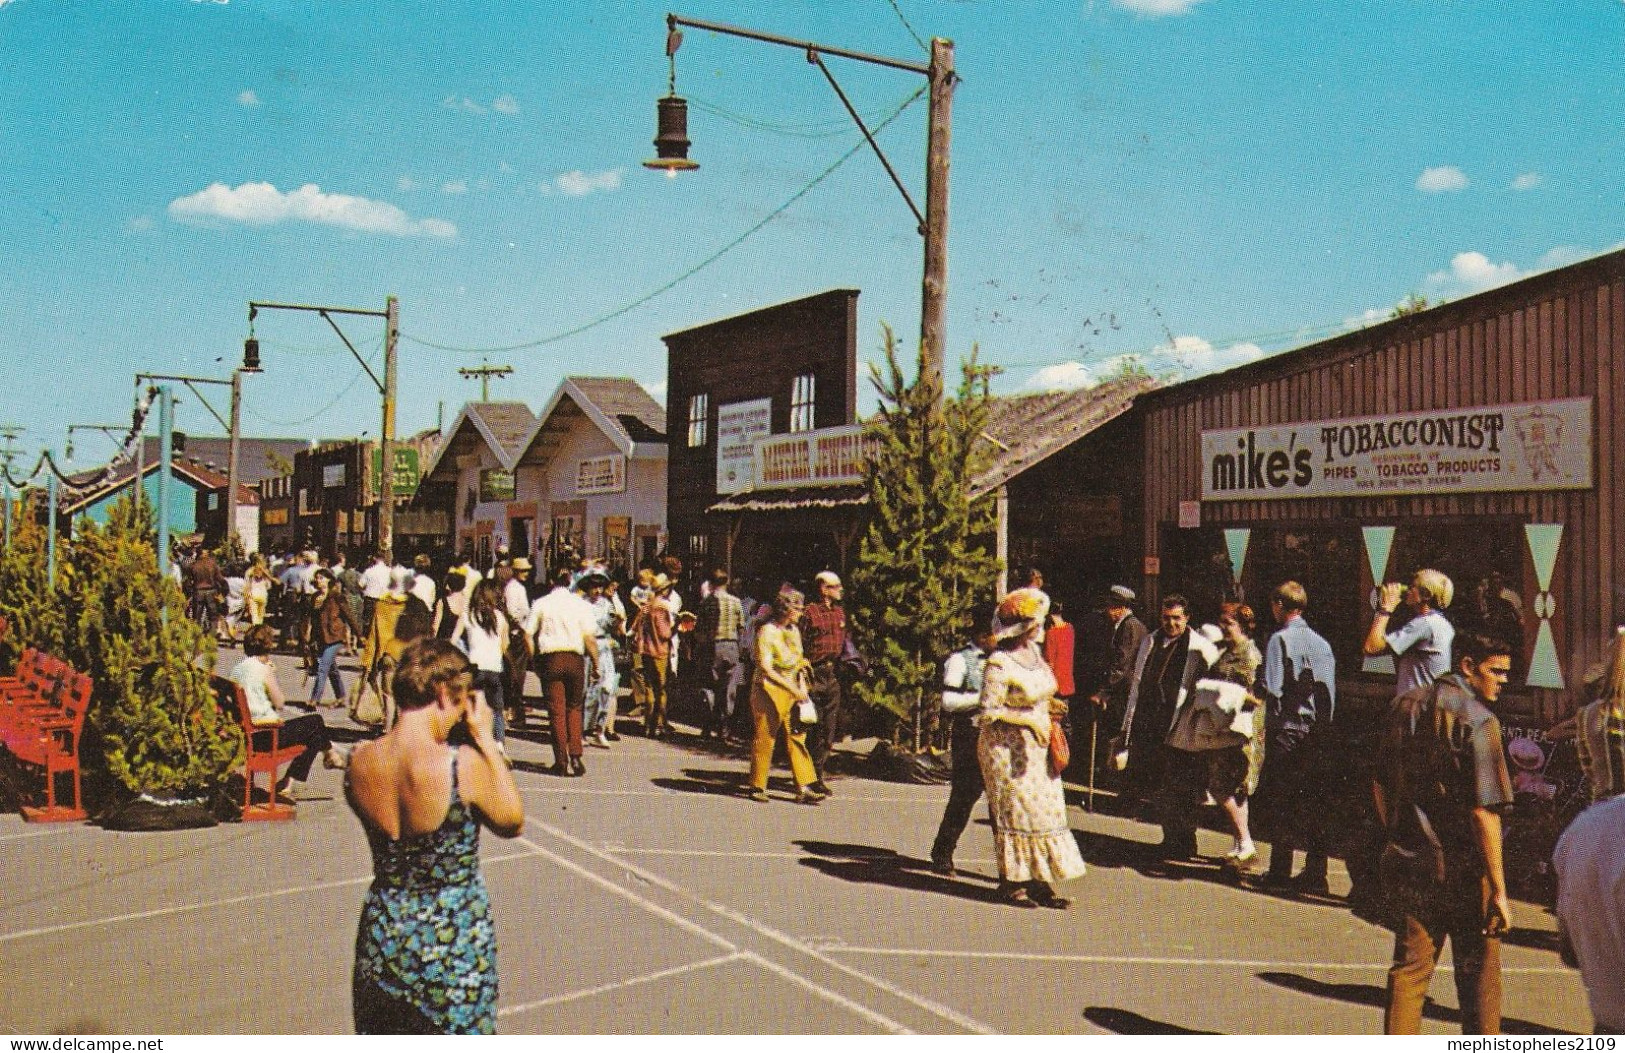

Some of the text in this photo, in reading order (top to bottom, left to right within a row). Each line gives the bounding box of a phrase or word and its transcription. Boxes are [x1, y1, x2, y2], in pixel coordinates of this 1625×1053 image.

[1212, 431, 1313, 490] mike's
[1321, 413, 1504, 462] TOBACCONIST
[1324, 458, 1500, 479] PIPES TOBACCO PRODUCTS
